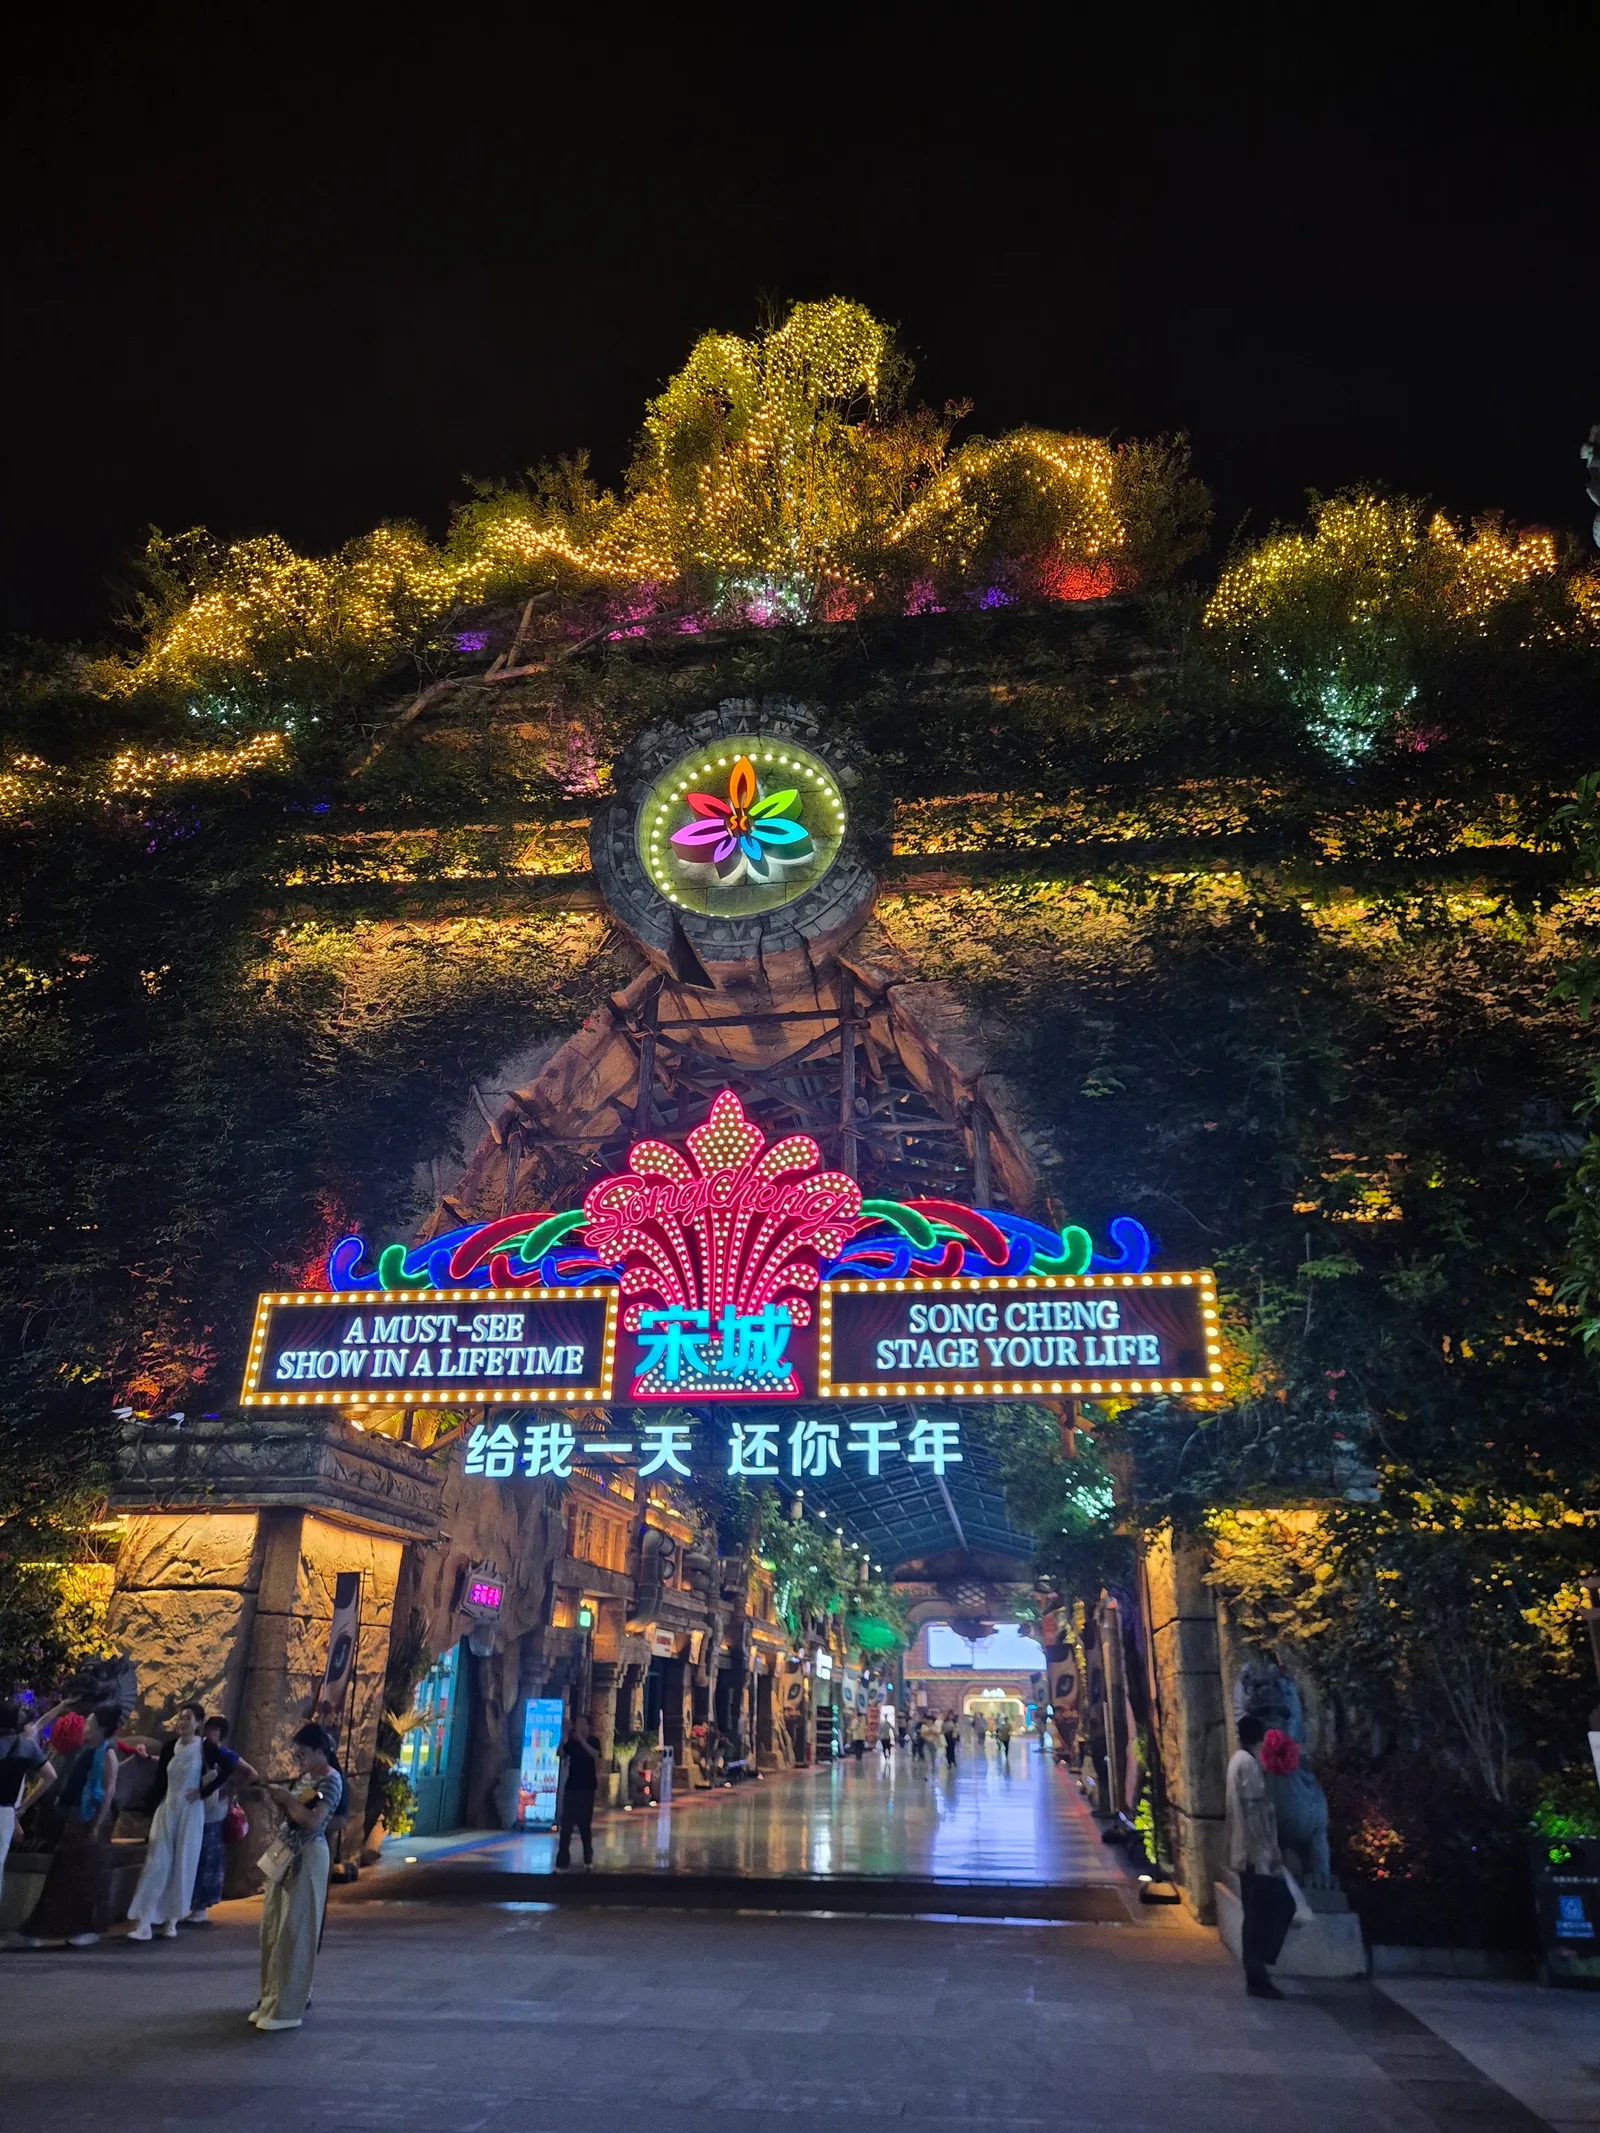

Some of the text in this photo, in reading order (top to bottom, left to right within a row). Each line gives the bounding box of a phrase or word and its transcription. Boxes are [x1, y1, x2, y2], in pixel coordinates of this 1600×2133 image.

[342, 1313, 525, 1344] A MUST-SEE
[908, 1300, 1121, 1333] SONG CHENG
[635, 1304, 792, 1380] 宋城
[876, 1334, 1161, 1370] STAGE YOUR LIFE
[276, 1345, 585, 1380] SHOW IN A LIFETIME
[464, 1418, 964, 1478] 给我一天 还你千年
